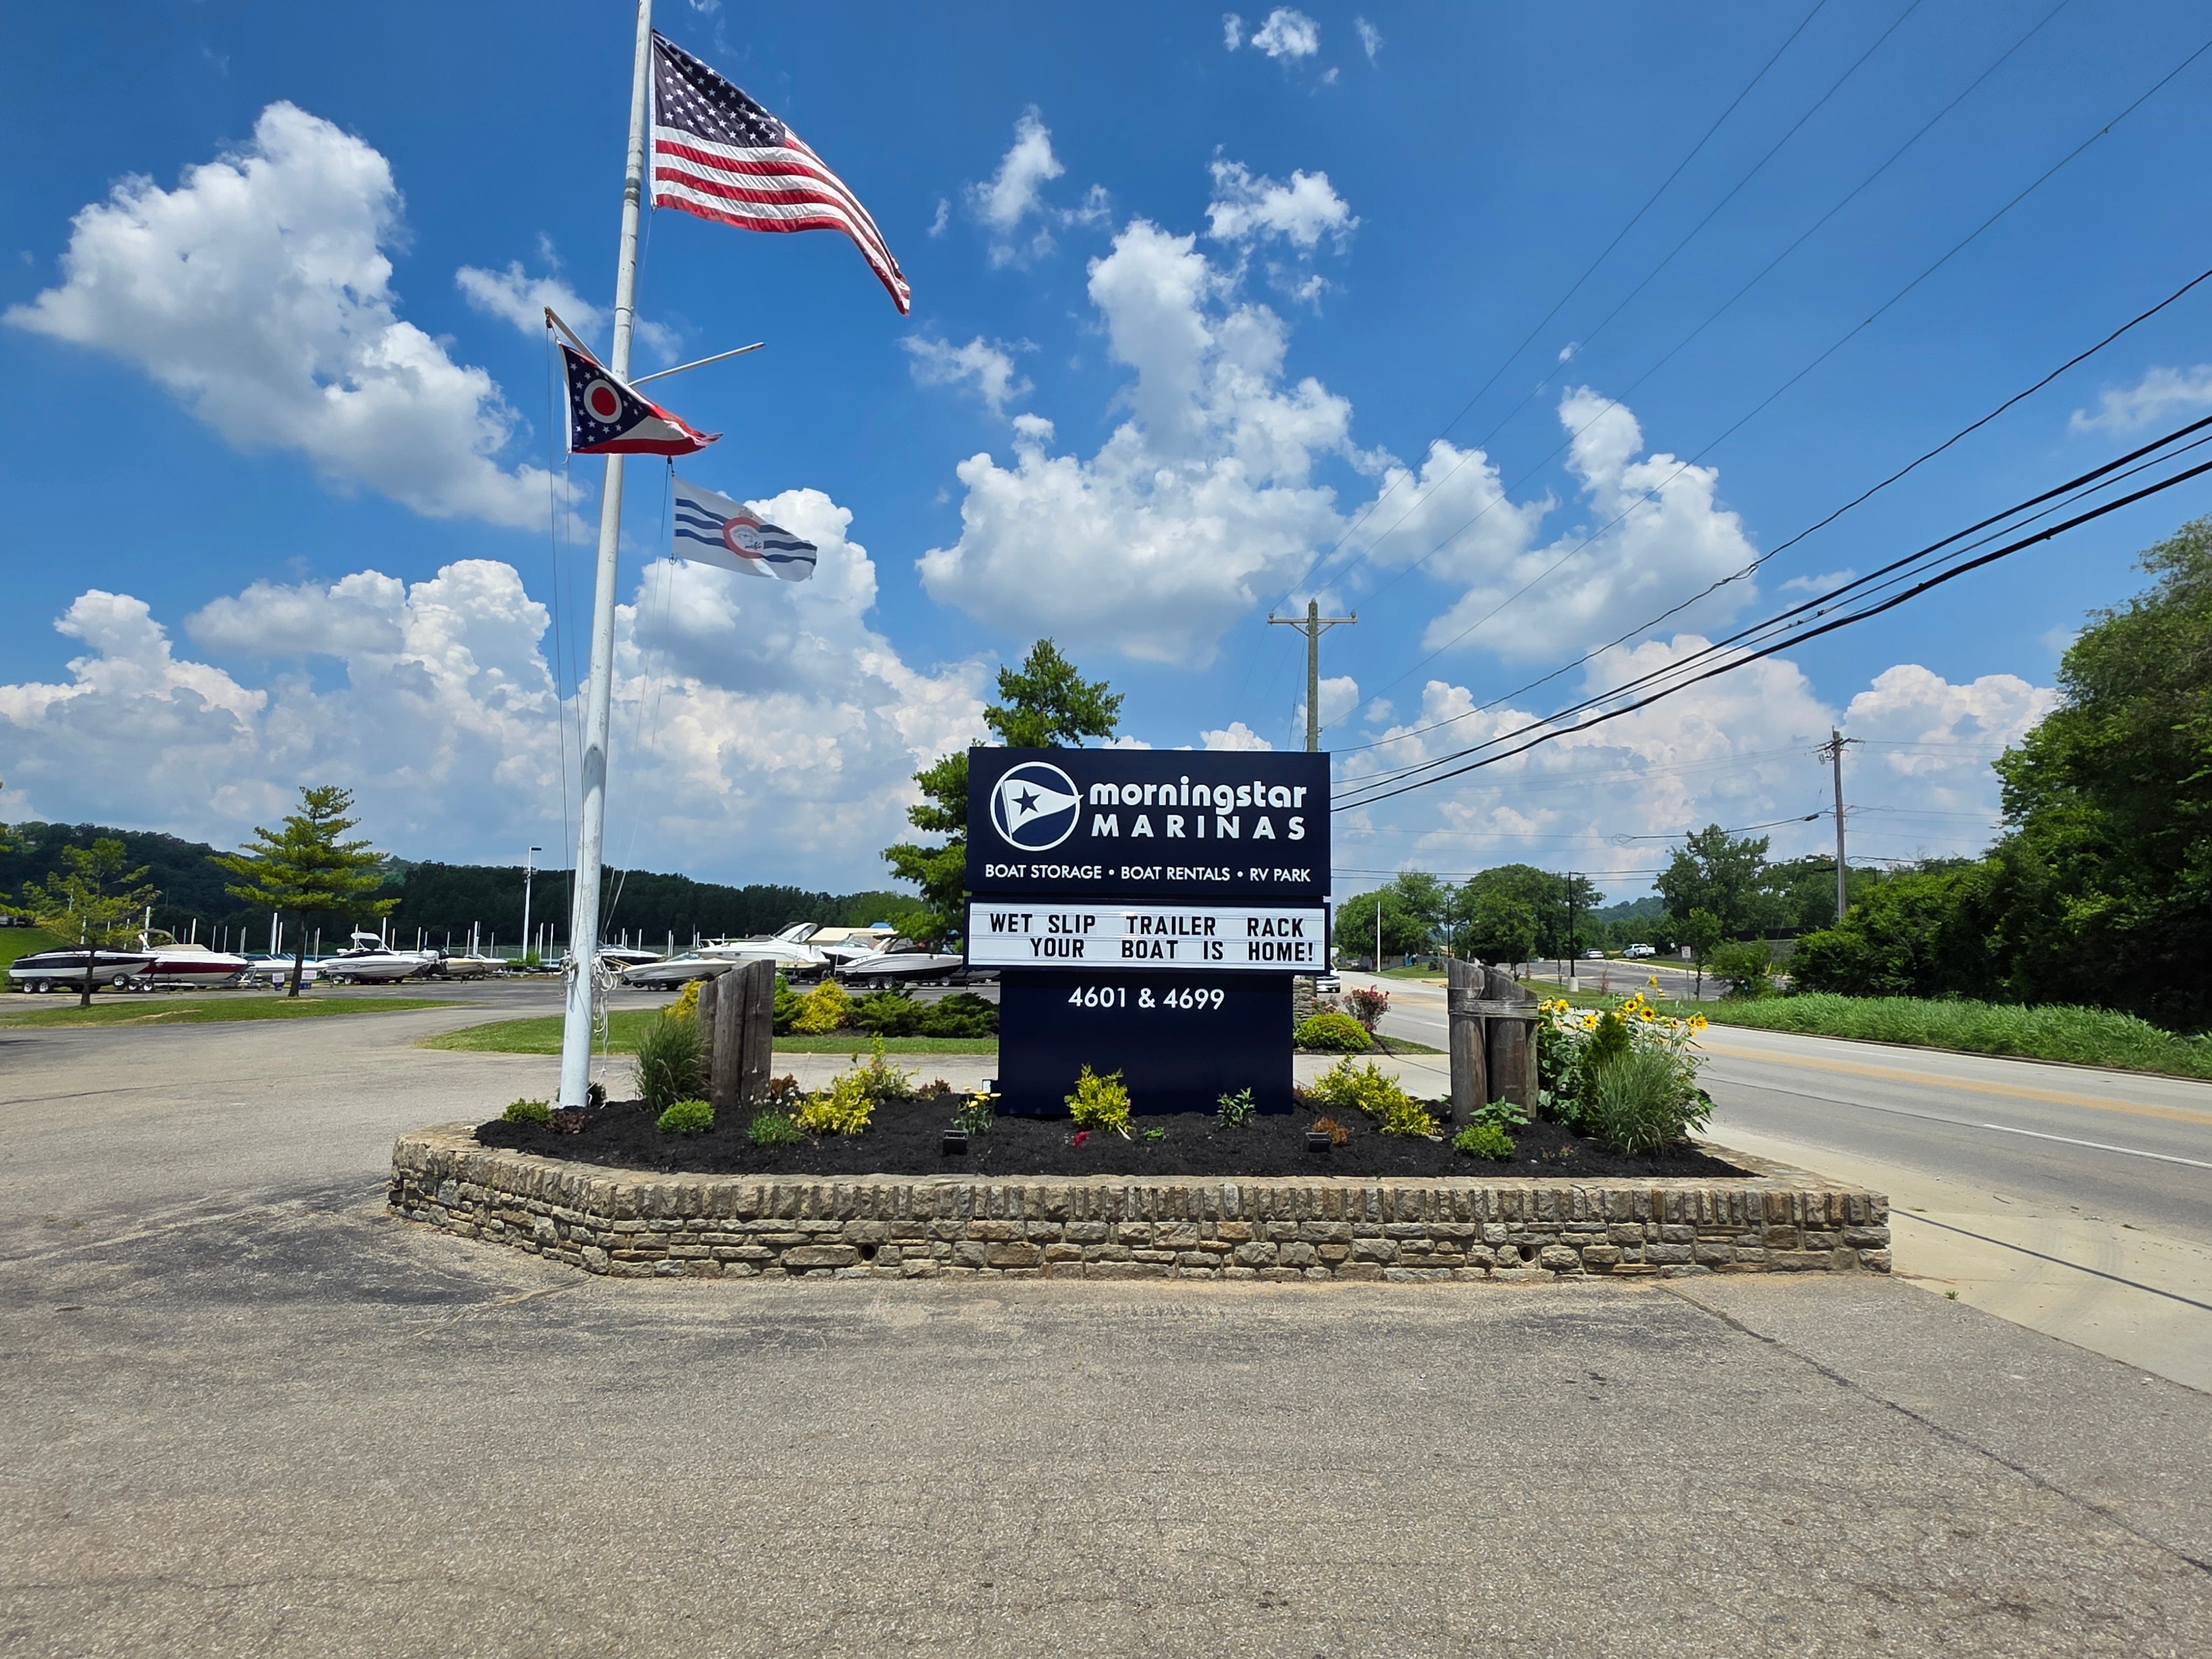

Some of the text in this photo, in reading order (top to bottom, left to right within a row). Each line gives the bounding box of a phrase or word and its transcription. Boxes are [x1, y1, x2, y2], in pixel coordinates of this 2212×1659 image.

[1089, 775, 1307, 815] morningstar
[1091, 813, 1305, 840] MARINAS
[985, 864, 1311, 882] BOAT STORAGE BOAT RENTALS RV PARK
[990, 913, 1303, 937] WET SLIP TRAILER RACK
[1030, 937, 1313, 962] YOUR BOAT IS HOME!
[1068, 986, 1224, 1010] 4601 & 4699
